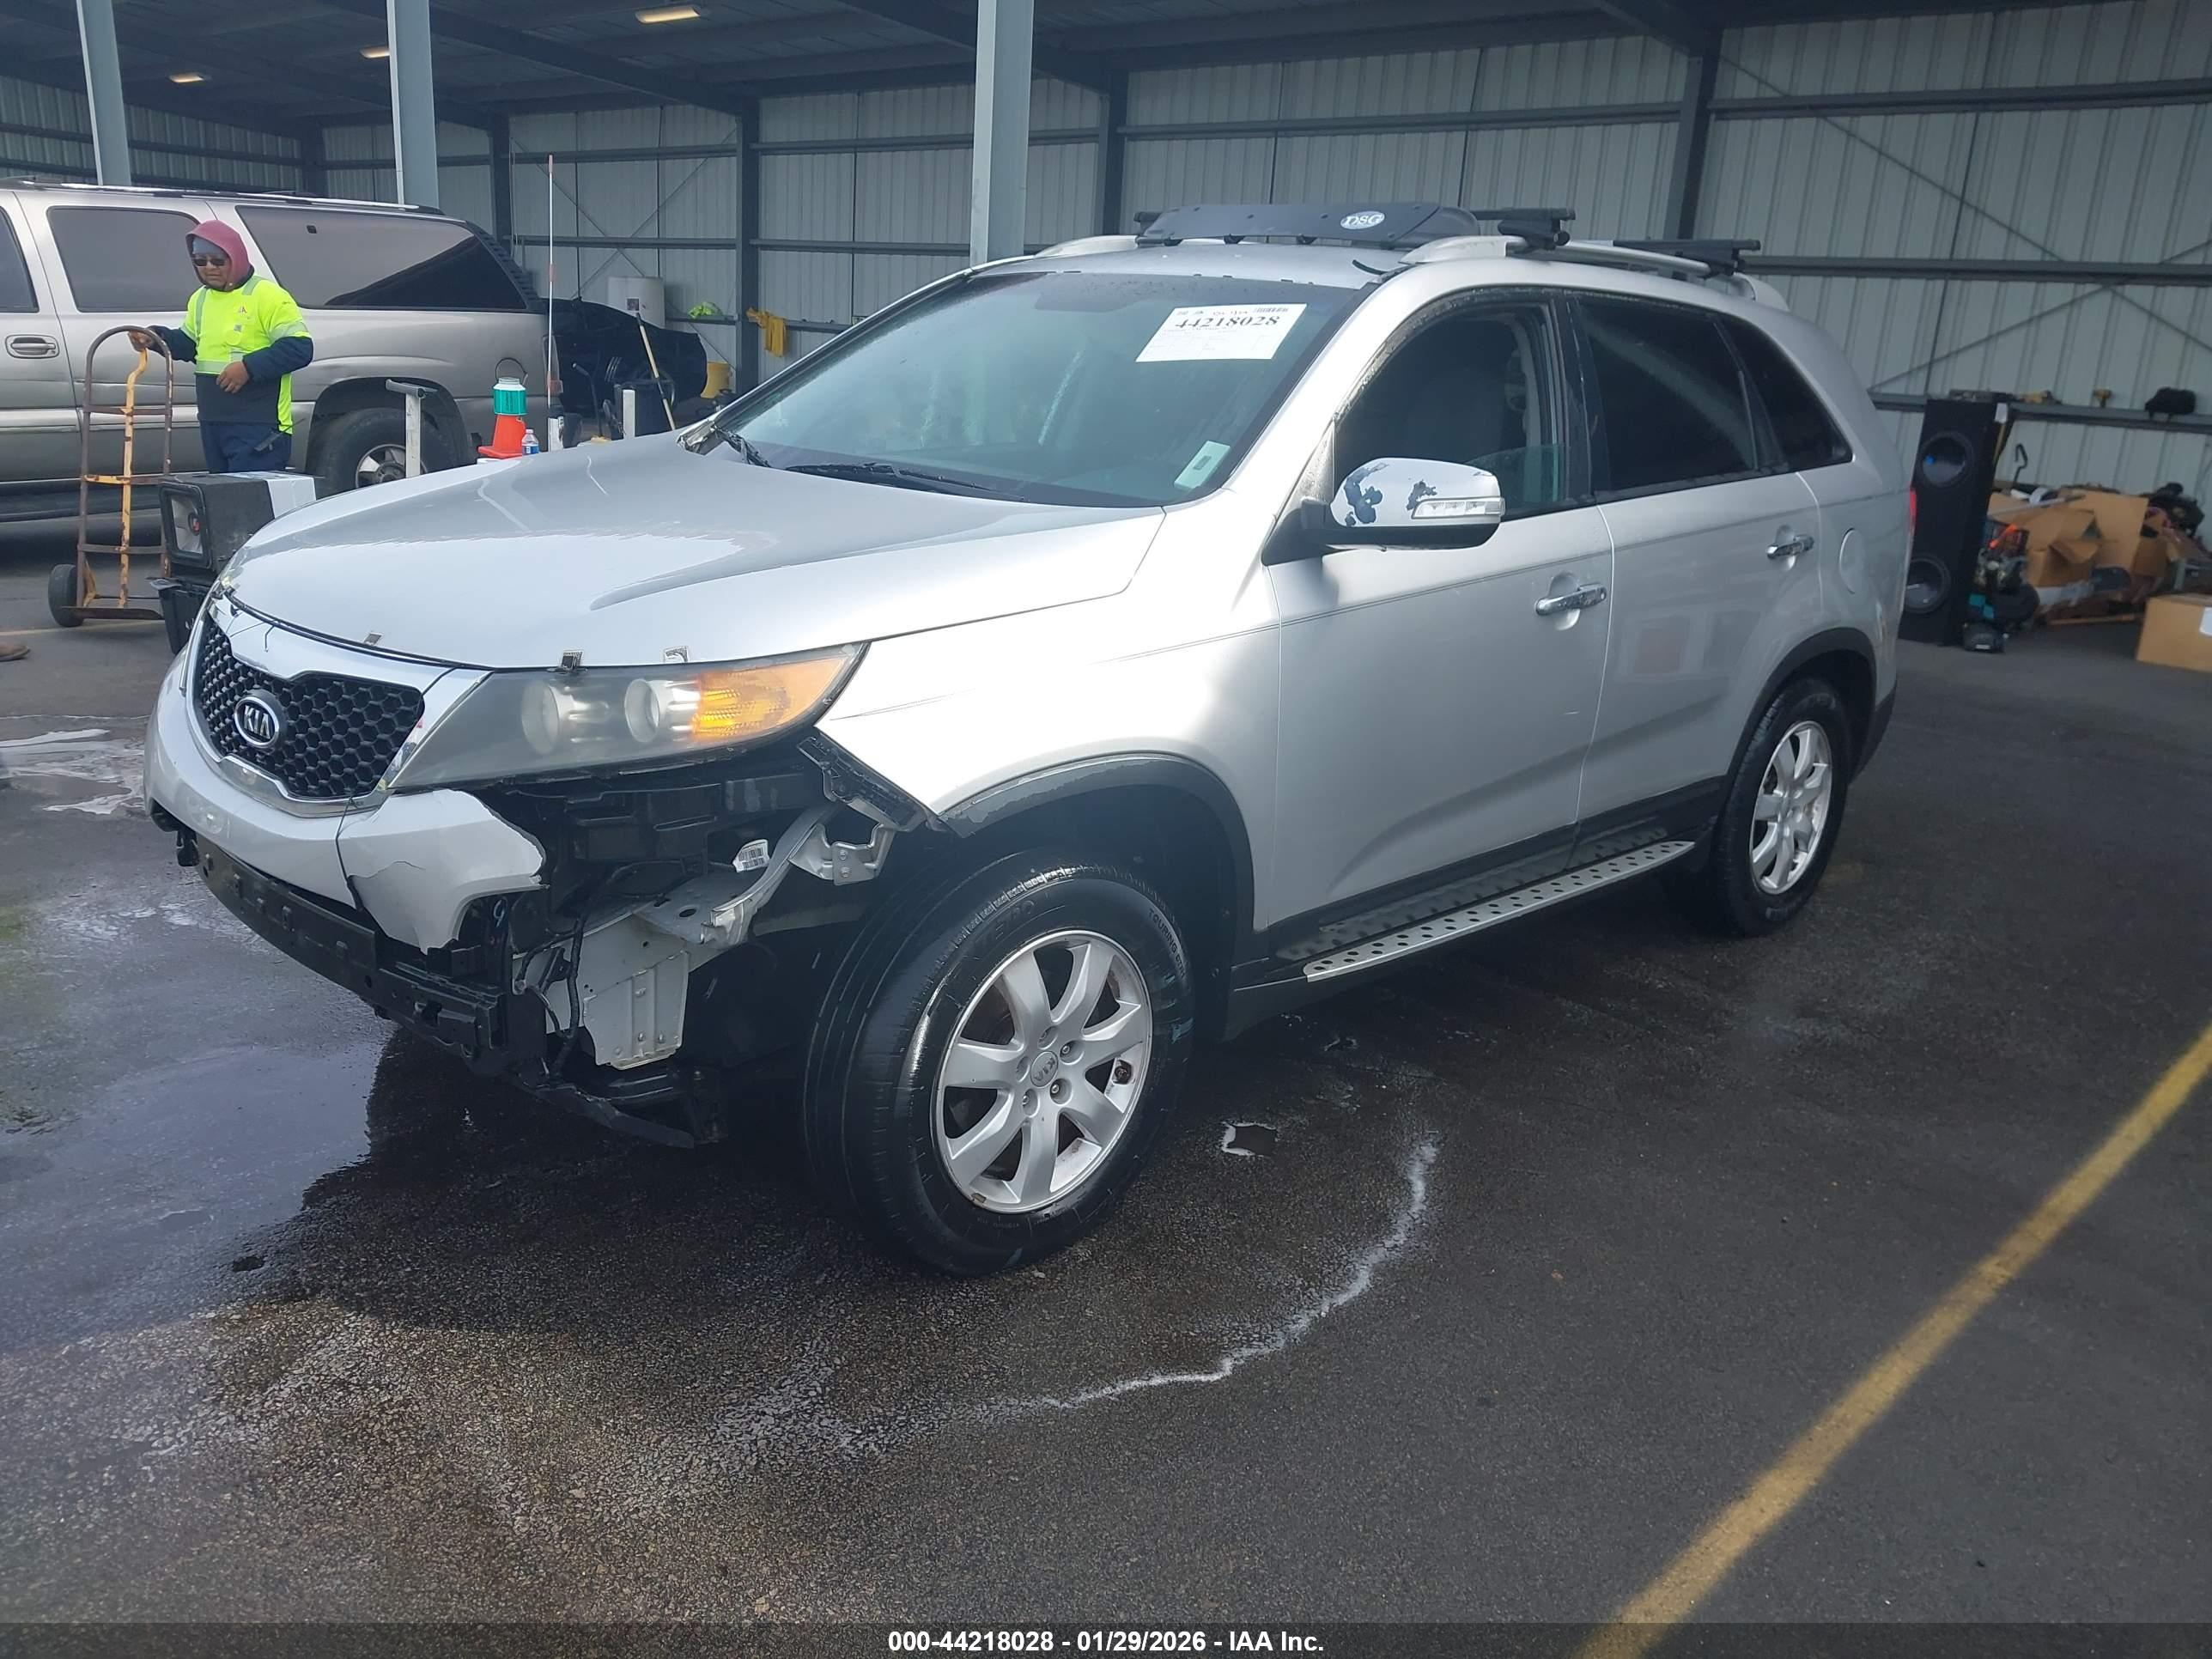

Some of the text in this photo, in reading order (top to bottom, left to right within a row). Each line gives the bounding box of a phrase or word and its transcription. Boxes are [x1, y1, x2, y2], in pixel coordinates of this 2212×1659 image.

[1175, 315, 1279, 329] 44218028
[243, 704, 271, 739] KIA
[1149, 908, 1178, 953] TOURING
